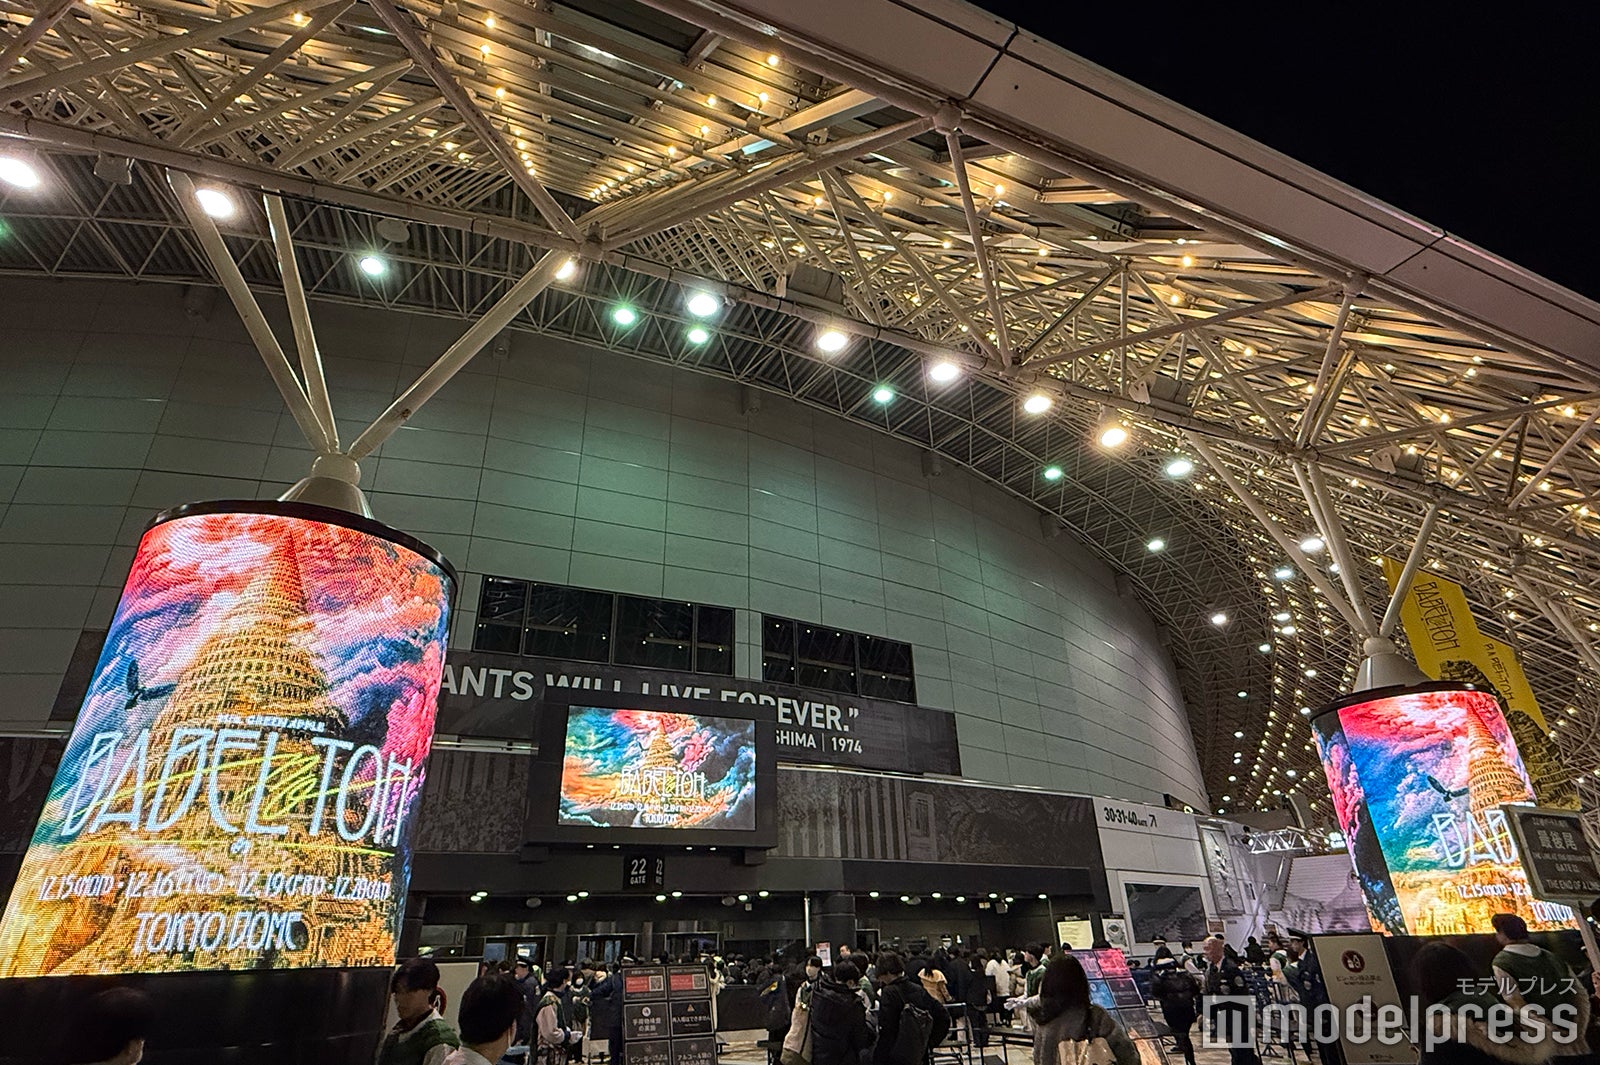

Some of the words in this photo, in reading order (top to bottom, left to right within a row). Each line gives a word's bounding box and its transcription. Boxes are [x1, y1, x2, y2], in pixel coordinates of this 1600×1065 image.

[830, 735, 863, 755] 1974
[61, 727, 289, 837] BABEL
[1536, 829, 1578, 851] 最後尾
[630, 858, 647, 875] 22
[630, 875, 646, 885] GATE
[131, 911, 227, 955] TOKYO
[226, 910, 303, 952] DOME
